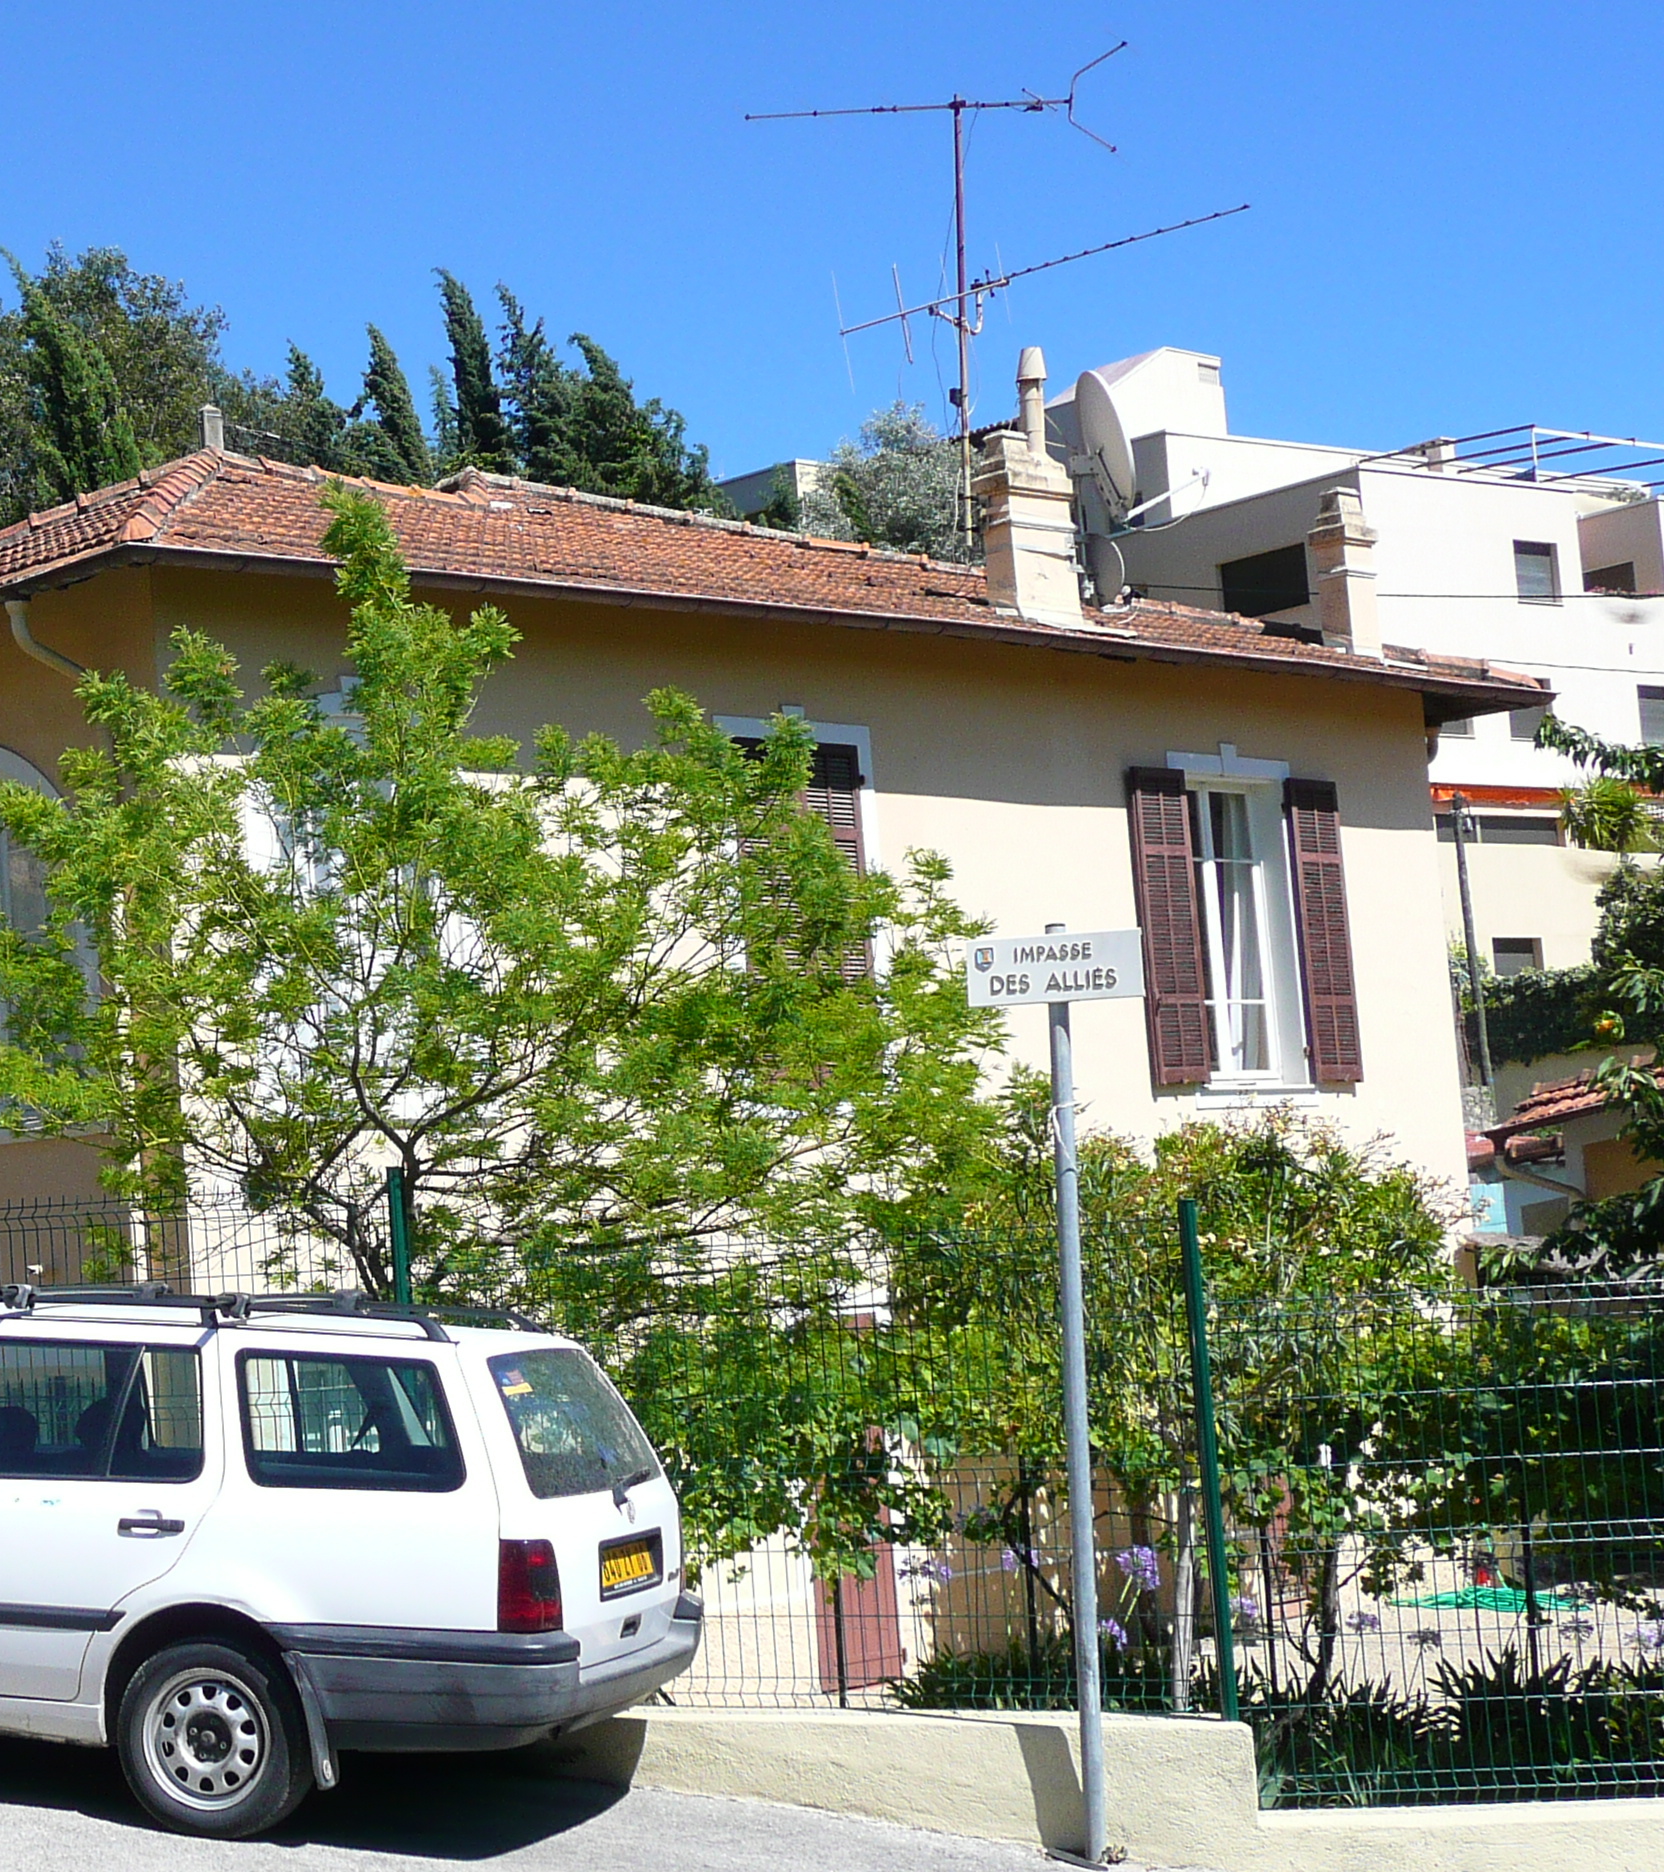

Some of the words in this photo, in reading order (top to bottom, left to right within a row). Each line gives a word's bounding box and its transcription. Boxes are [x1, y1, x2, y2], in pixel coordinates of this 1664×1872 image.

[1013, 942, 1092, 964] IMPASSE
[990, 973, 1030, 996] DES
[1045, 966, 1117, 993] ALLIÉS
